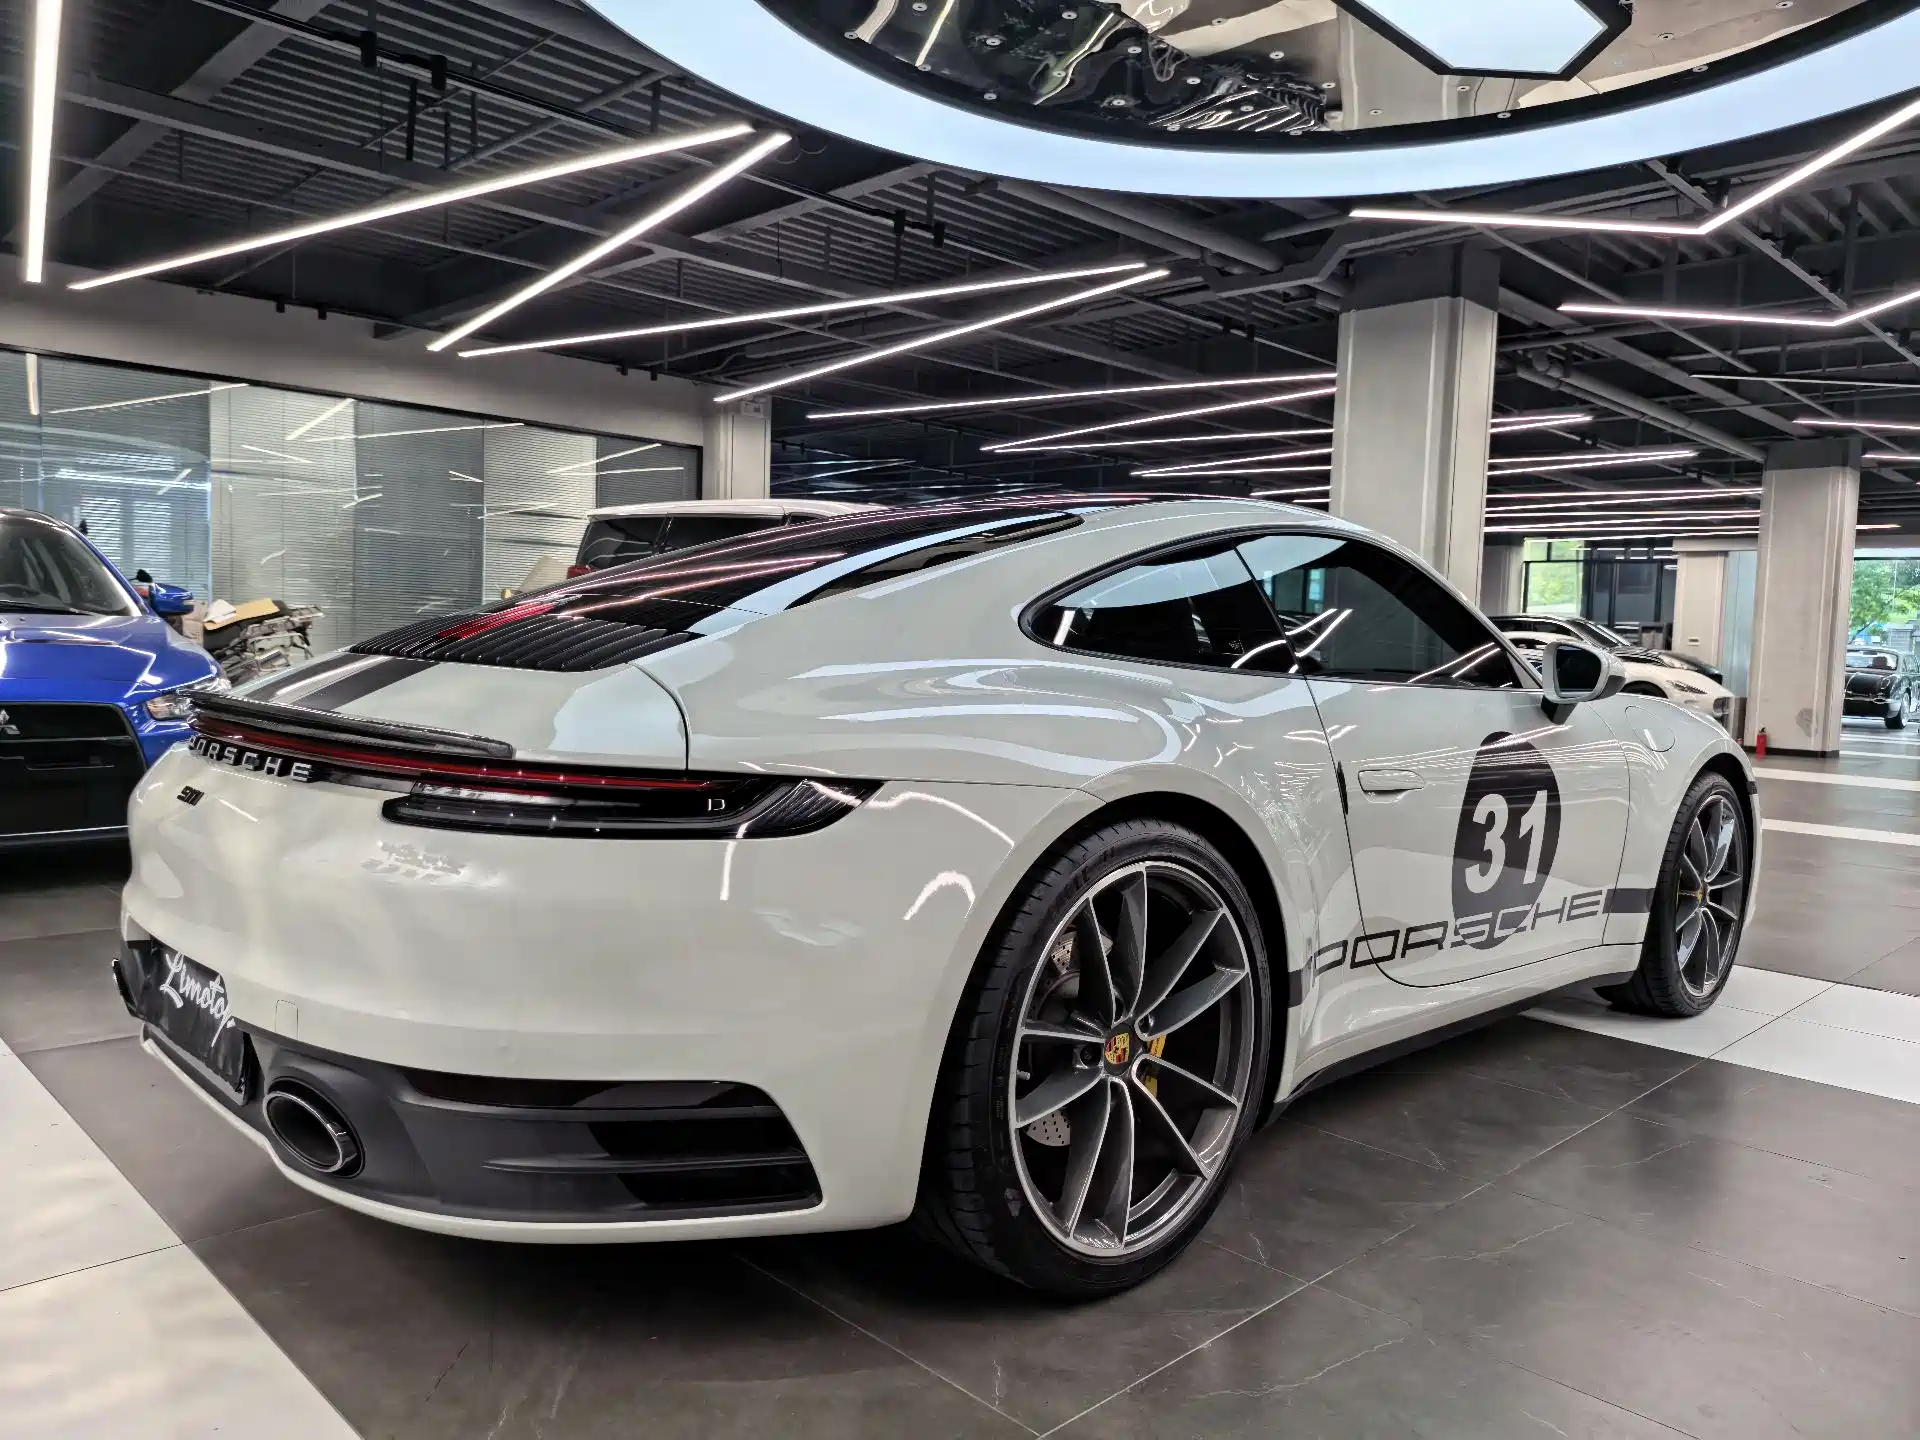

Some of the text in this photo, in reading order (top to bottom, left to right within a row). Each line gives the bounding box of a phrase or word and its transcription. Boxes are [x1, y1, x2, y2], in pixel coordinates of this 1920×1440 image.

[188, 735, 312, 782] PORSCHE
[1465, 790, 1548, 893] 31
[1313, 889, 1603, 978] PORSCHE
